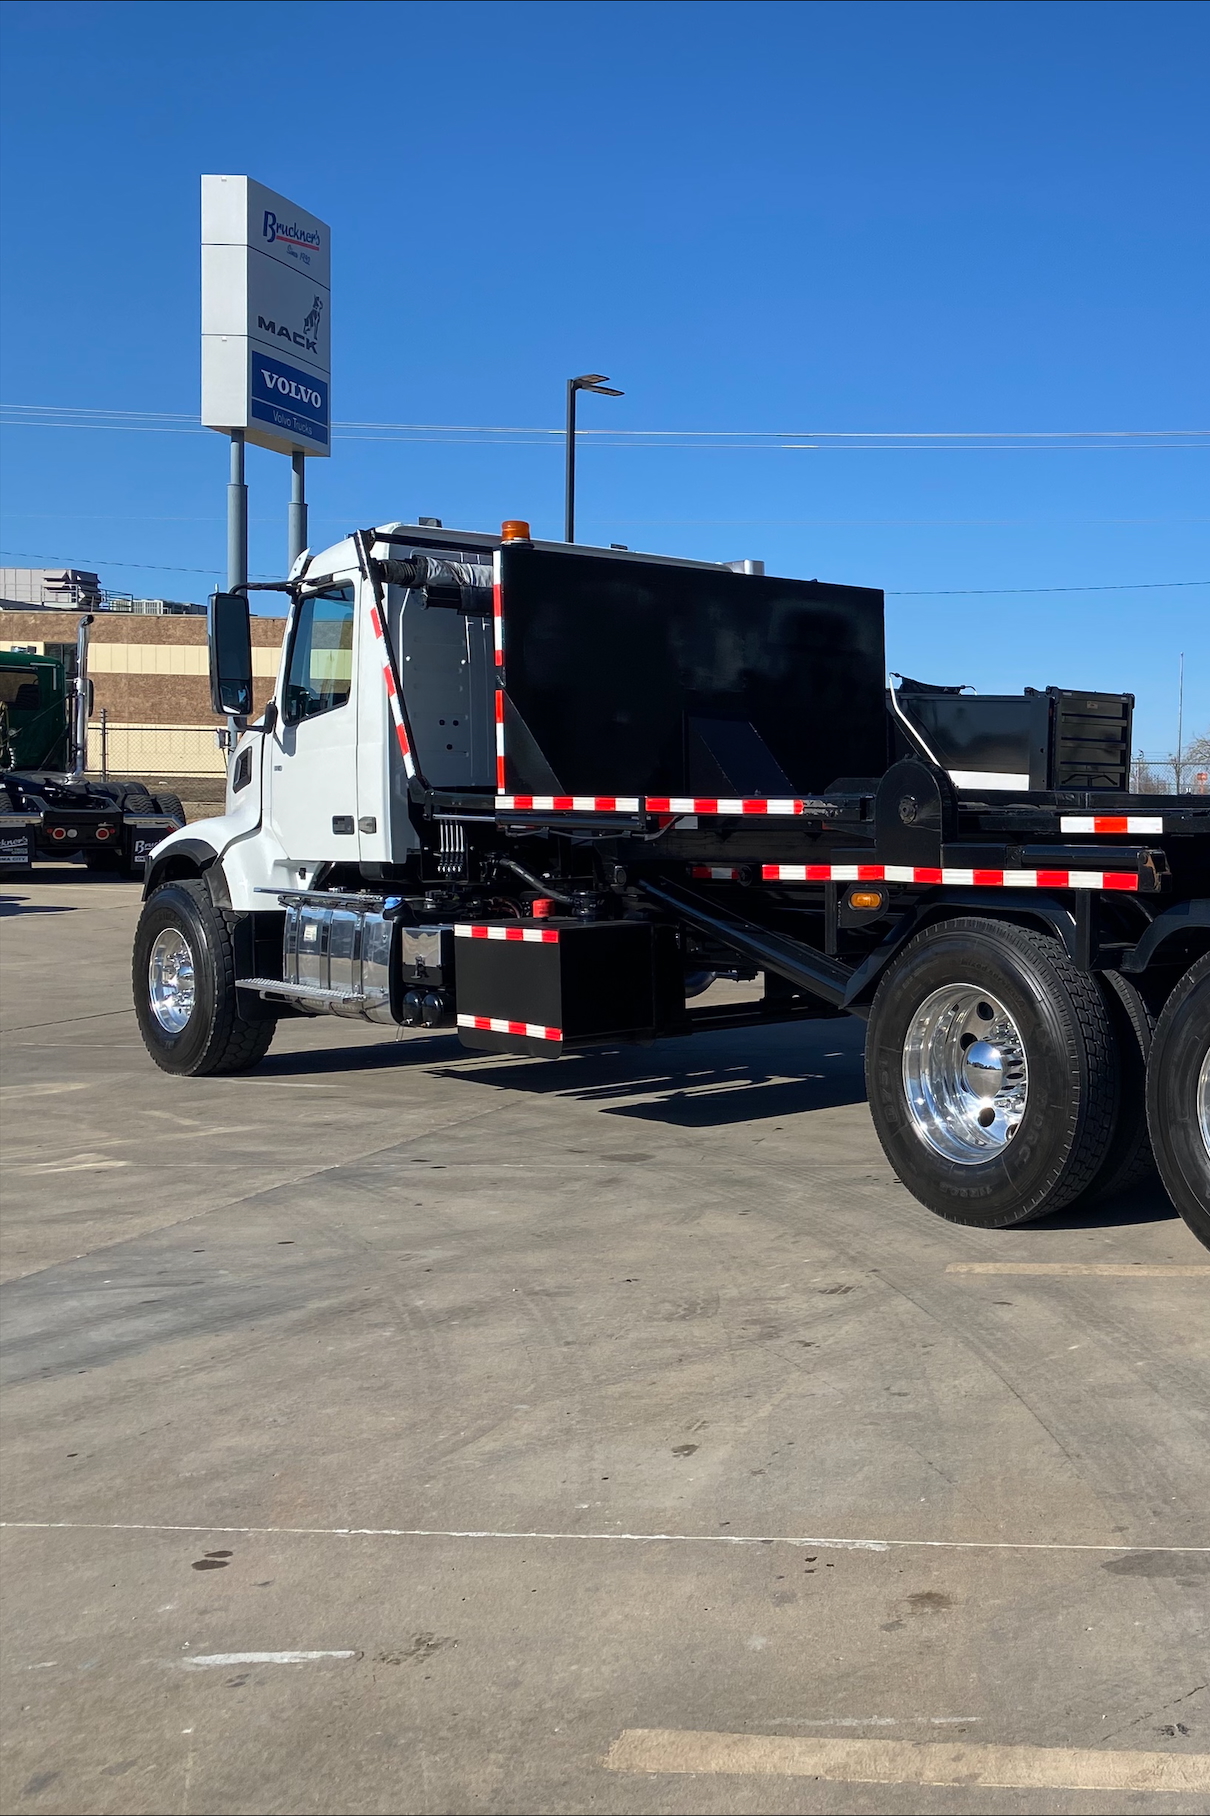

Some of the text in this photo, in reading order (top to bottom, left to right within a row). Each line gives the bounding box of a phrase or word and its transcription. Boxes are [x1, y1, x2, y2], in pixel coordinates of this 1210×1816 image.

[262, 210, 321, 246] Bruckner's
[257, 315, 319, 354] MACK
[261, 369, 322, 409] VOLVO
[272, 409, 313, 436] Volvo Trucks
